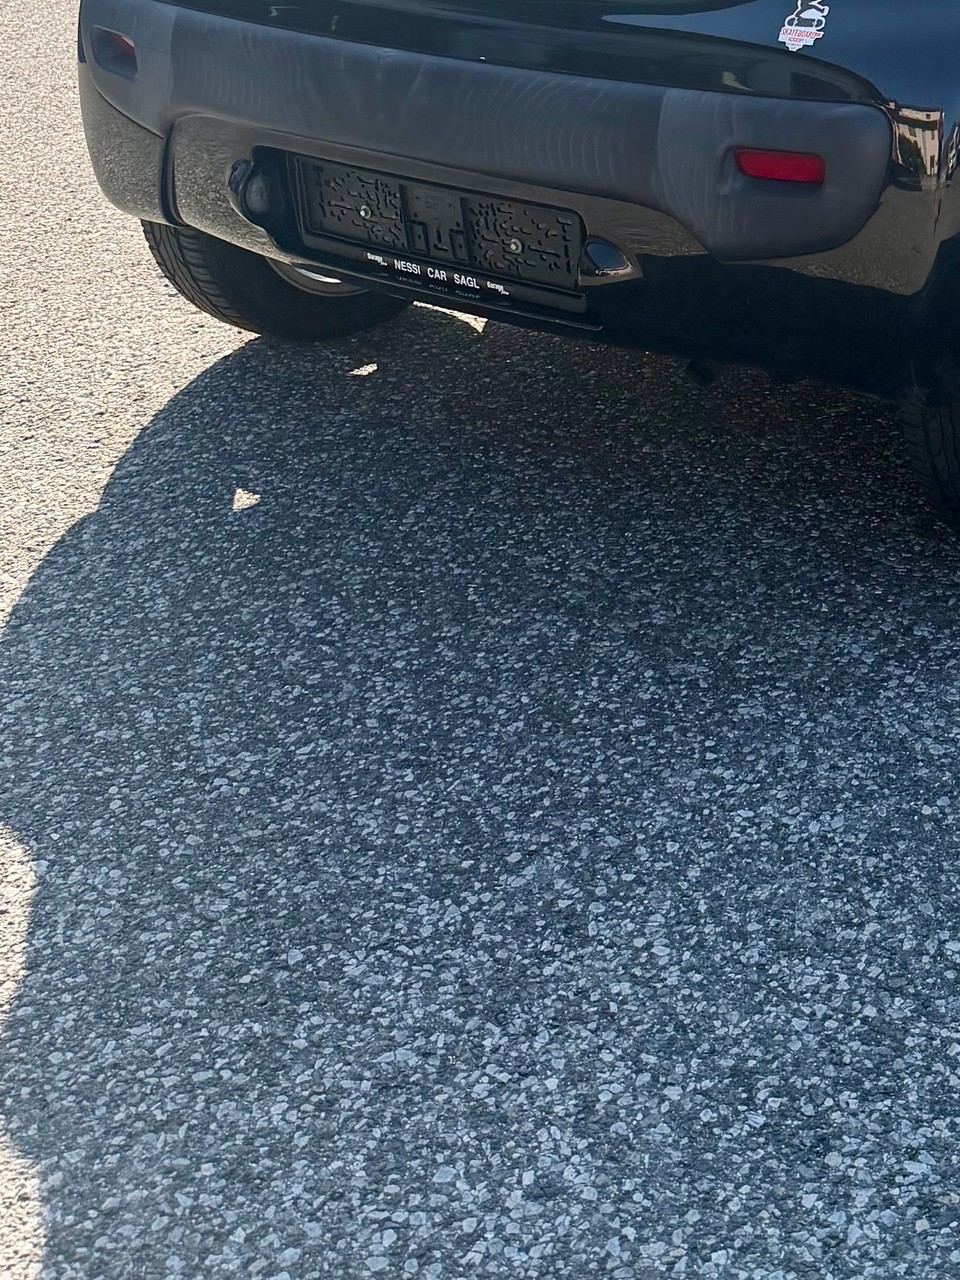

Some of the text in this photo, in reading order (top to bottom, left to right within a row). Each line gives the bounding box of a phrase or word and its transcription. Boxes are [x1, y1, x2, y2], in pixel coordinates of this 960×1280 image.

[394, 259, 480, 289] NESSI CAR SAGL
